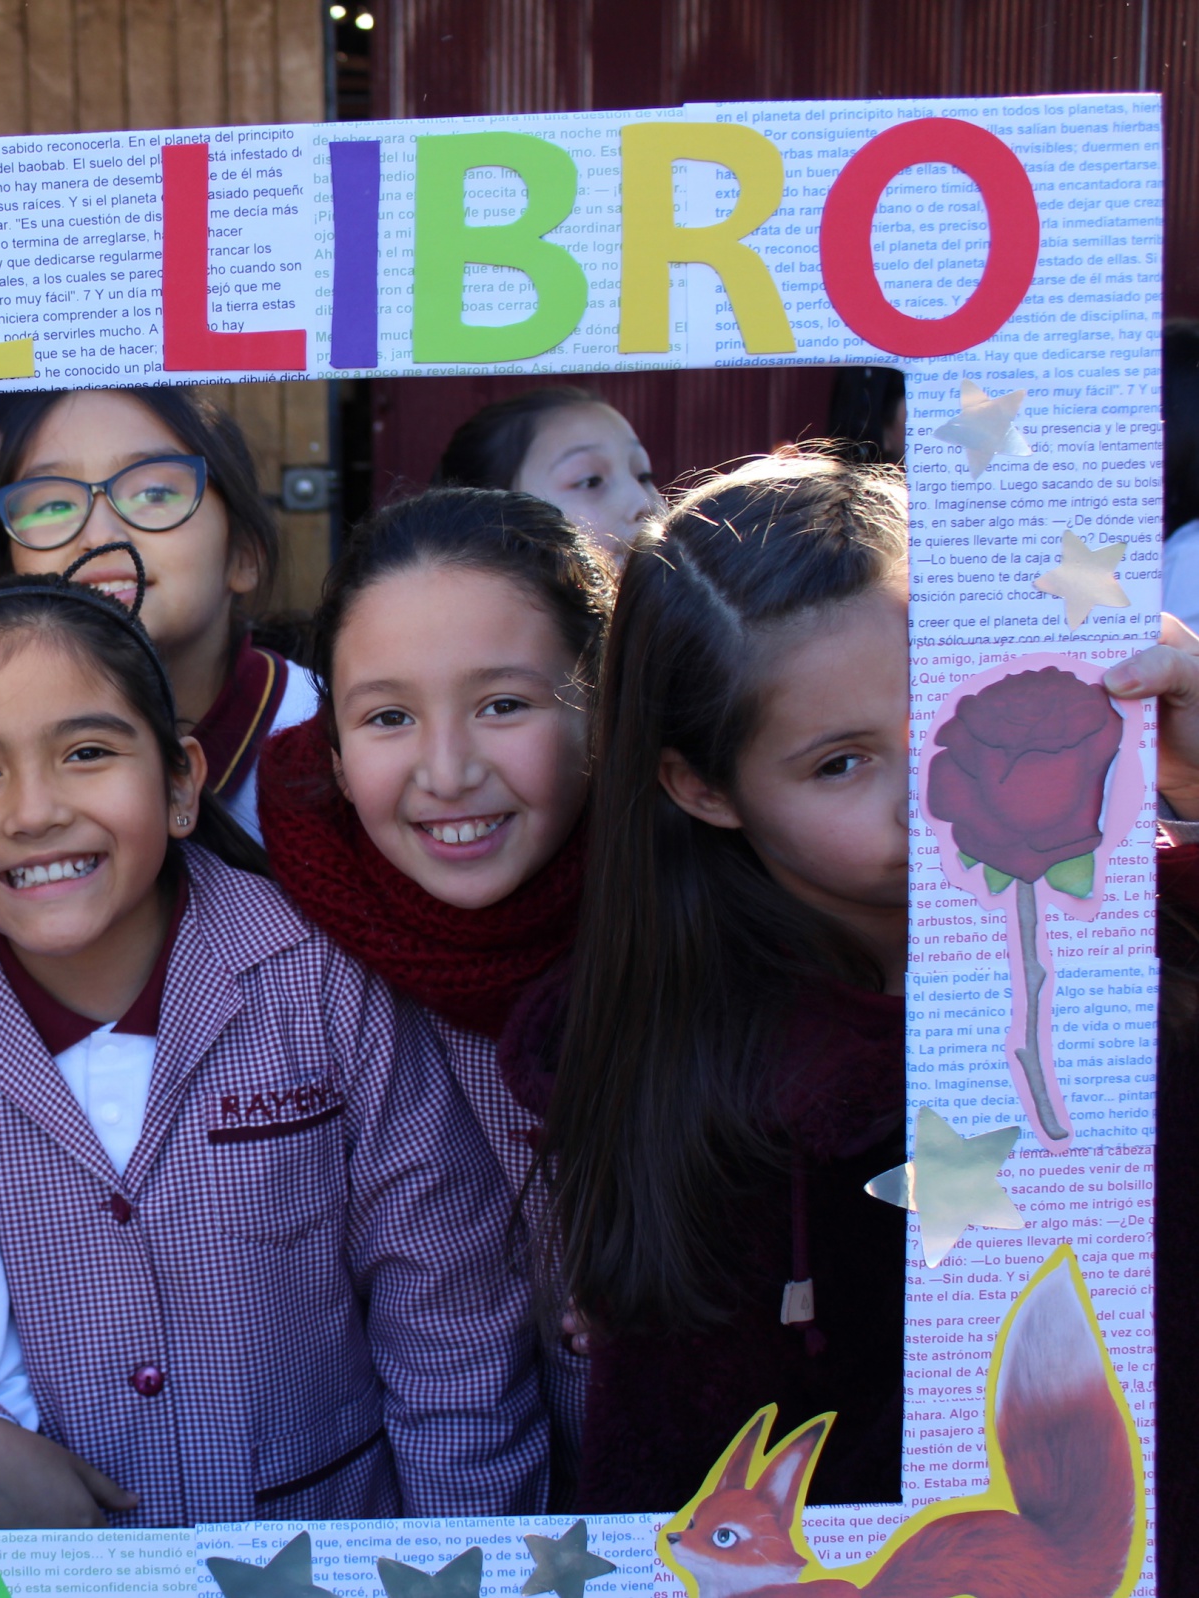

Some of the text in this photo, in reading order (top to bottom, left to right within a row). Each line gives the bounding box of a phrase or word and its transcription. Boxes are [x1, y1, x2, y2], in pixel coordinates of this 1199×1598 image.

[715, 104, 1128, 125] en el planeta del principito había, como en todos los planetas,
[1, 141, 44, 155] sabido
[46, 136, 124, 153] reconocerla.
[128, 135, 146, 148] En
[149, 134, 161, 147] el
[214, 130, 234, 143] del
[237, 128, 295, 145] principito
[790, 127, 878, 143] consiguiente
[230, 146, 289, 162] infestado
[1082, 141, 1140, 153] duermen
[17, 158, 69, 173] baobab.
[72, 157, 86, 170] El
[89, 155, 124, 169] suelo
[126, 154, 146, 167] del
[1058, 178, 1142, 191] encantadora
[41, 211, 141, 229] una cuestión de
[11, 231, 150, 249] termina de arreglarse,
[162, 117, 1040, 371] LIBRO
[229, 260, 302, 275] cuando son
[43, 270, 126, 285] los cuales se
[1068, 291, 1141, 304] demasiado
[225, 298, 296, 313] tierra estas
[42, 307, 119, 324] comprender
[43, 324, 145, 341] servirles mucho.
[915, 477, 1132, 495] largo tiempo. Luego sacando de su
[934, 495, 1139, 513] Imagínense cómo me intrigó esta
[959, 589, 1004, 605] pareció
[916, 914, 977, 927] arbustos,
[943, 1002, 1132, 1019] mecánico alguno,
[938, 1042, 989, 1057] primera
[1074, 1074, 1132, 1087] sorpresa
[1108, 1107, 1150, 1119] herido
[1010, 1179, 1153, 1195] sacando de su bolsillo
[1077, 1231, 1153, 1245] mi cordero?
[919, 1425, 974, 1441] pasajero
[330, 1519, 399, 1533] respondió;
[41, 1531, 94, 1543] mirando
[345, 1535, 442, 1548] encima de eso,
[332, 1570, 377, 1582] tesoro.
[55, 1581, 159, 1594] semiconfidencia
